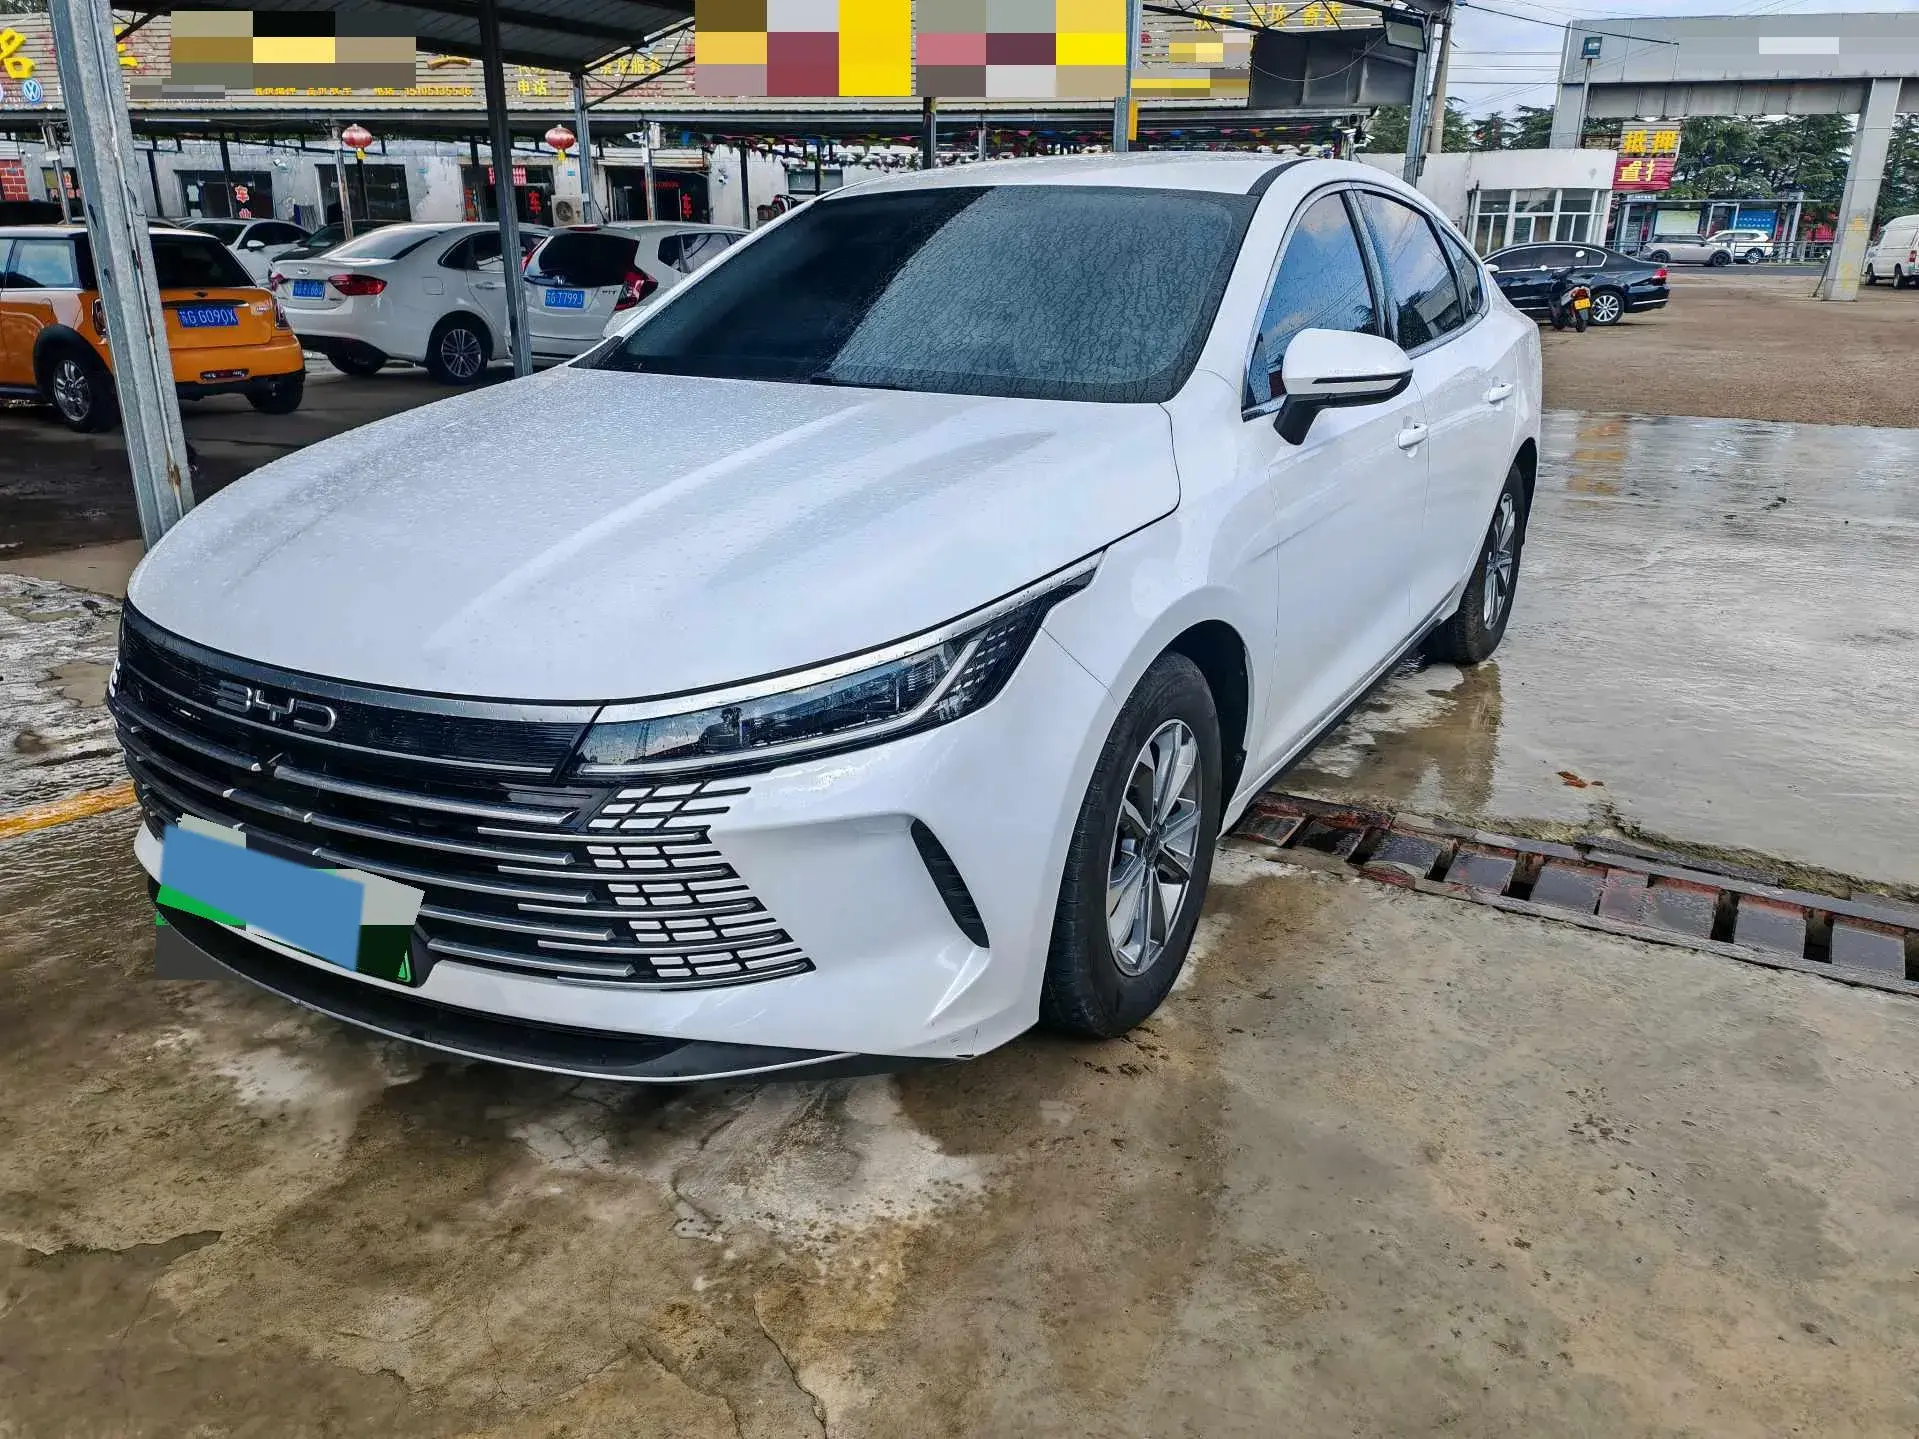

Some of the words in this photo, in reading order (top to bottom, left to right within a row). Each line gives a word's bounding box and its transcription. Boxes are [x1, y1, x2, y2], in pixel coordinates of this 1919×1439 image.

[517, 79, 547, 96] 电话
[1624, 129, 1678, 154] 抵押
[216, 679, 338, 733] BYD
